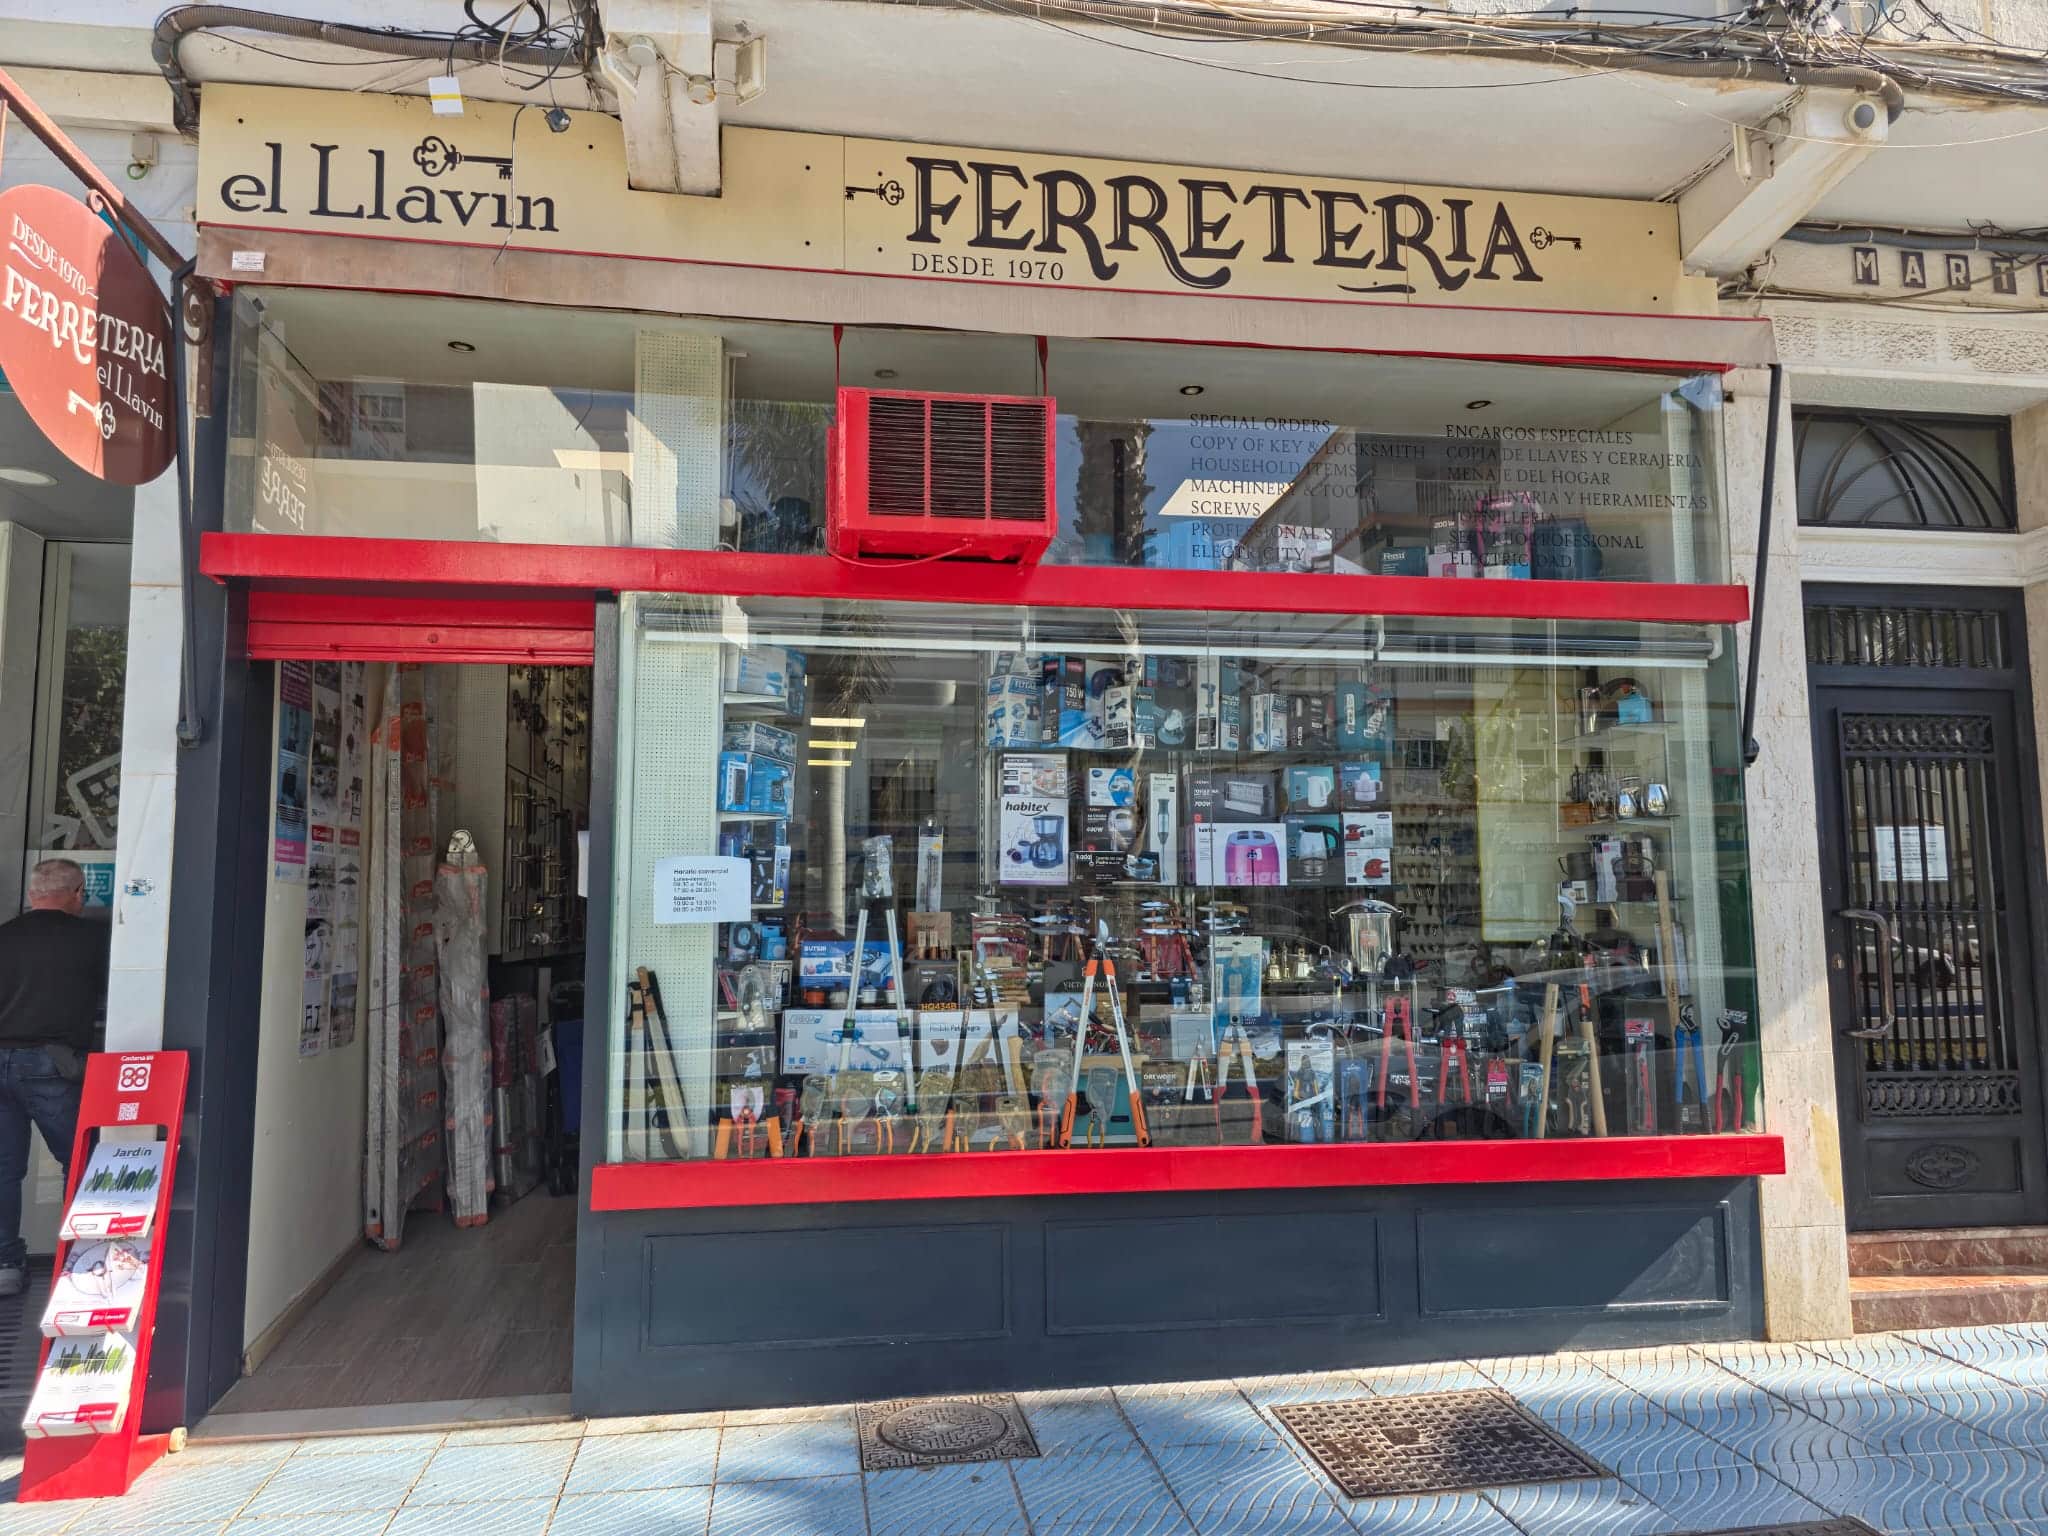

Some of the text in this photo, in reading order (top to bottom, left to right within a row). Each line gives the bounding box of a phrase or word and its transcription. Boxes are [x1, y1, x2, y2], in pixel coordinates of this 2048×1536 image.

[220, 143, 287, 214] el
[906, 156, 1544, 292] FERRETERIA
[12, 212, 87, 297] DESDE 1970
[912, 252, 1064, 282] DESDE 1970
[3, 264, 167, 381] FERRETERIA
[97, 360, 164, 431] el Llavín
[1190, 413, 1331, 433] SPECIAL ORDERS
[1446, 424, 1633, 445] ENCARGOS ESPECIALES
[1190, 435, 1425, 459] COPY OF KEY & LOCKSMITH
[1446, 446, 1497, 460] COPIA
[1503, 448, 1523, 462] DE
[1528, 448, 1588, 464] LLAVES
[1593, 451, 1603, 464] Y
[1191, 456, 1357, 477] HOUSEHOLD ITEMS
[1518, 469, 1545, 483] DEL
[1552, 470, 1611, 486] HOGAR
[1191, 480, 1296, 497] MACHINERY
[1191, 501, 1262, 516] SCREWS
[1565, 491, 1575, 504] Y
[1580, 491, 1708, 510] HERRAMIENTAS
[1005, 801, 1051, 816] habitex
